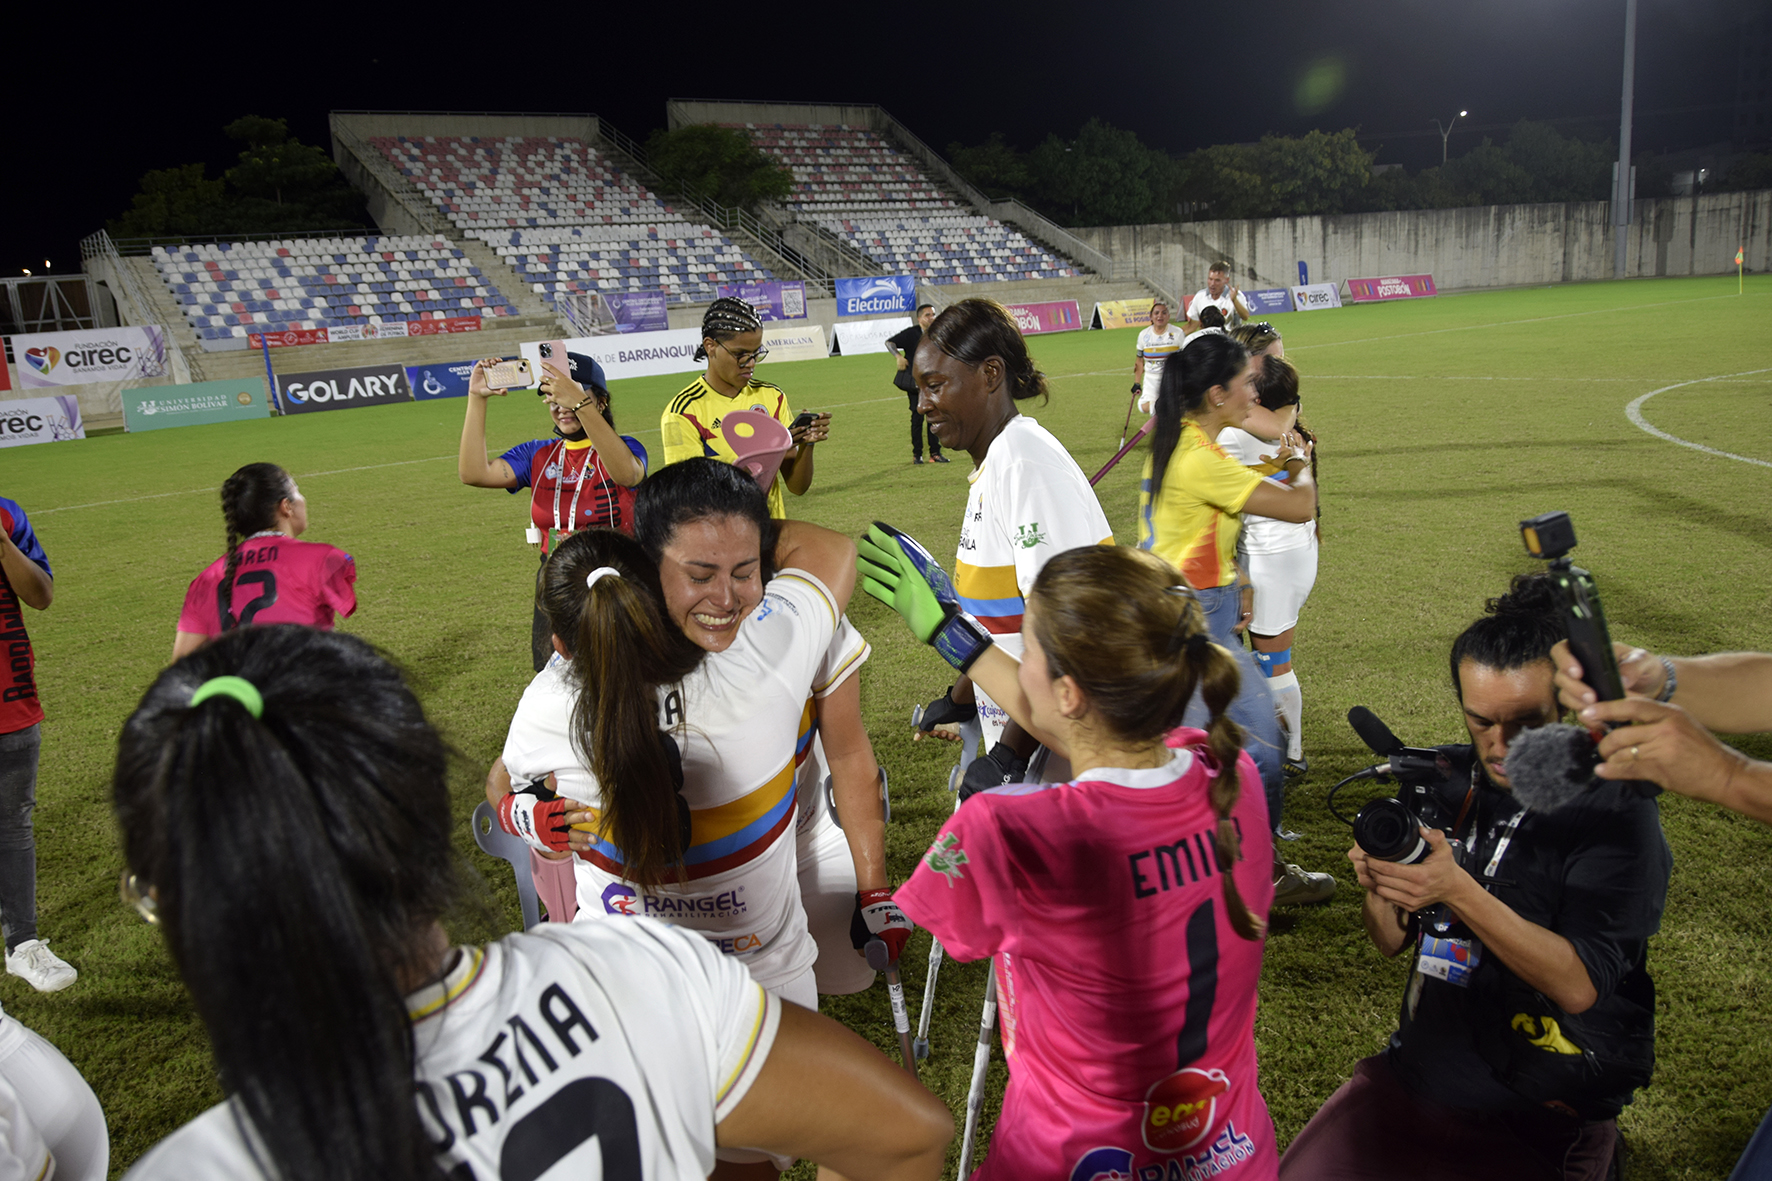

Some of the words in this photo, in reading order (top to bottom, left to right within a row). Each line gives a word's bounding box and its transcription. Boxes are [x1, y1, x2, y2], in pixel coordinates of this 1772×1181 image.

[1377, 282, 1411, 298] POSTOBÓN
[847, 295, 905, 314] Electrolit
[1309, 293, 1329, 304] cirec
[74, 341, 118, 350] FUNDACIÓN
[766, 337, 813, 346] AMERICANA
[64, 347, 132, 368] cirec
[605, 354, 616, 363] DE
[159, 394, 227, 406] UNIVERSIDAD
[160, 403, 190, 413] SIMÓN
[191, 400, 228, 410] BOLÍVAR
[222, 545, 280, 572] AREN
[643, 890, 746, 913] RANGEL
[645, 906, 747, 918] REHABILITACIÓN
[1177, 897, 1219, 1070] 1
